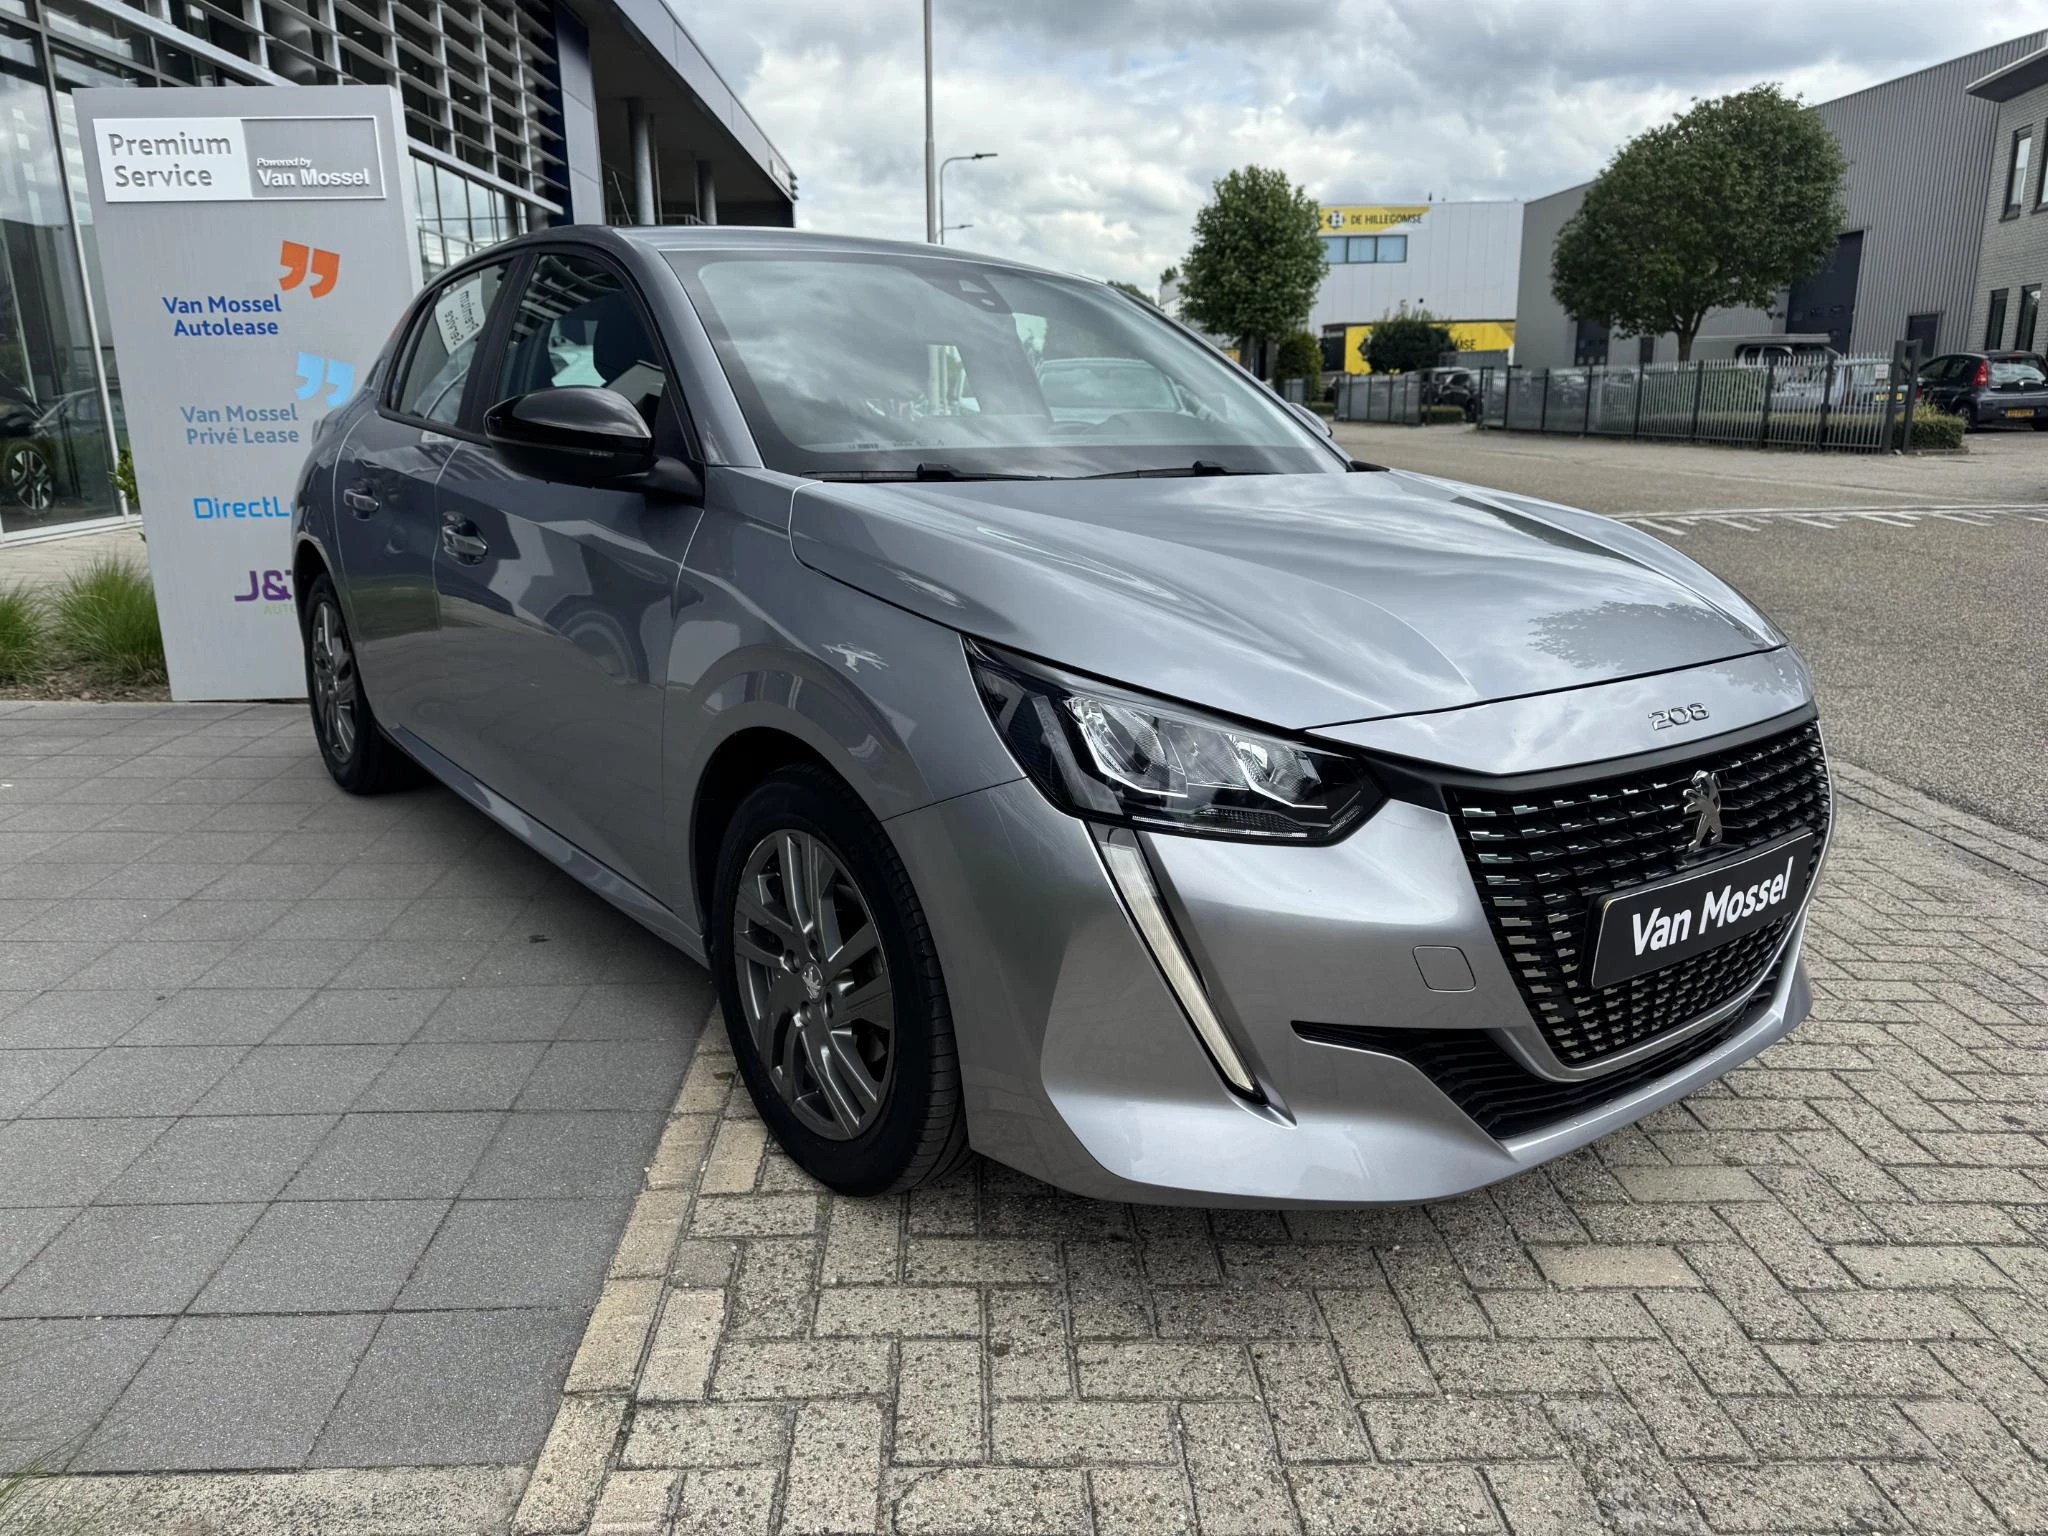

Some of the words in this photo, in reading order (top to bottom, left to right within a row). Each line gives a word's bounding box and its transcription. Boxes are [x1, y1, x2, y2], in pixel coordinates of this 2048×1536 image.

[108, 131, 232, 156] Premium
[256, 157, 299, 167] Powered
[300, 156, 313, 168] by
[113, 163, 213, 188] Service
[257, 168, 296, 187] Van
[300, 167, 370, 187] Mossel
[162, 296, 202, 314] Van
[208, 293, 282, 313] Mossel
[173, 317, 279, 337] Autolease
[180, 405, 221, 423] Van
[226, 402, 299, 422] Mossel
[186, 426, 238, 445] Privé
[243, 428, 299, 445] Lease
[1648, 702, 1710, 731] 208
[1632, 906, 1692, 956] Van
[1698, 856, 1794, 934] Mossel
